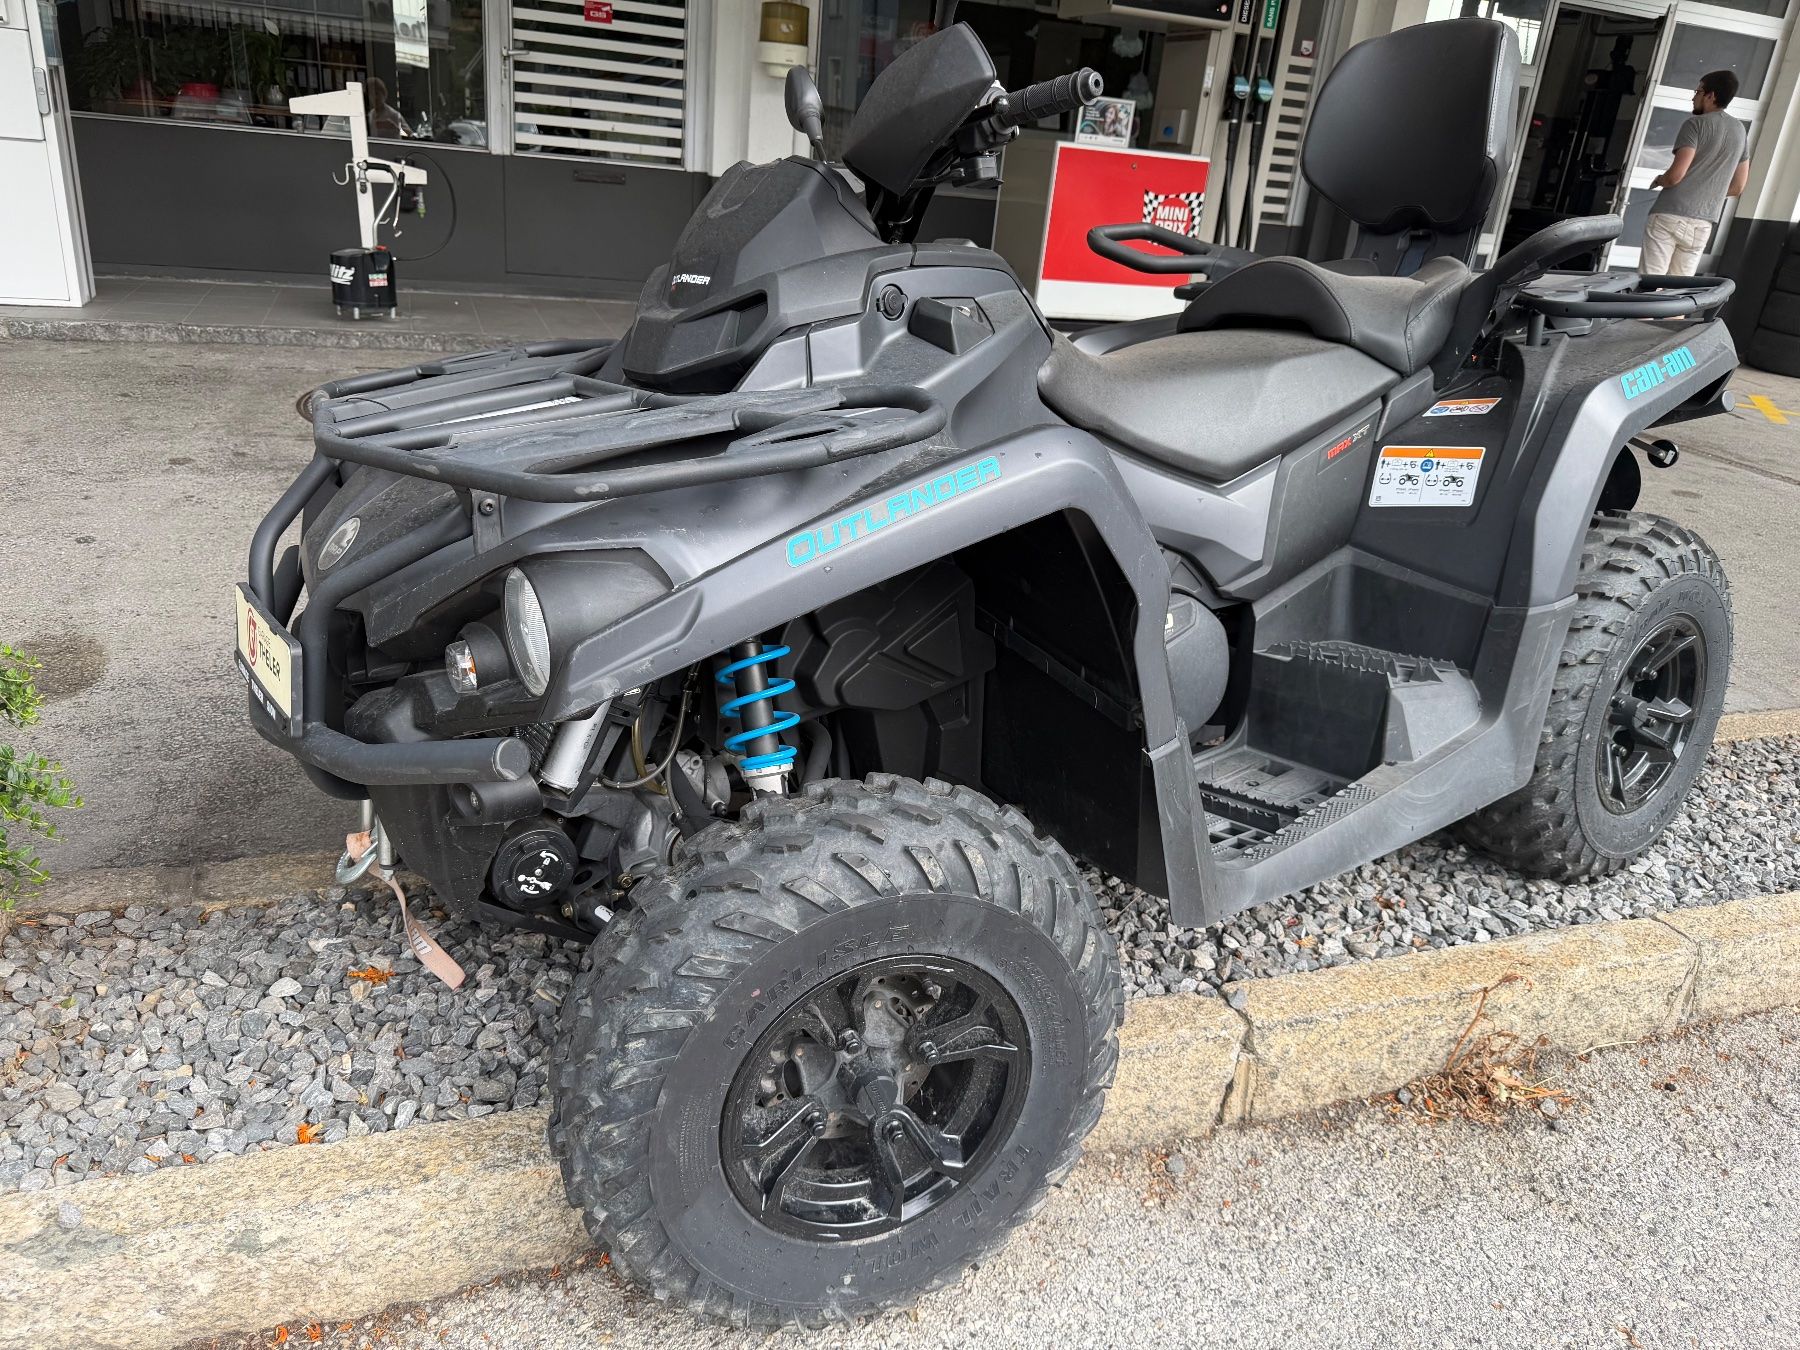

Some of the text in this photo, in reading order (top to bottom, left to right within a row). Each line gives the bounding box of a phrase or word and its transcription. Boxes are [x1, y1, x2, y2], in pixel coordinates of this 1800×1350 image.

[1156, 205, 1189, 222] MINI
[329, 263, 355, 281] litz
[1620, 346, 1697, 400] can-am
[786, 456, 1002, 568] OUTLANDER
[258, 640, 281, 682] THELER
